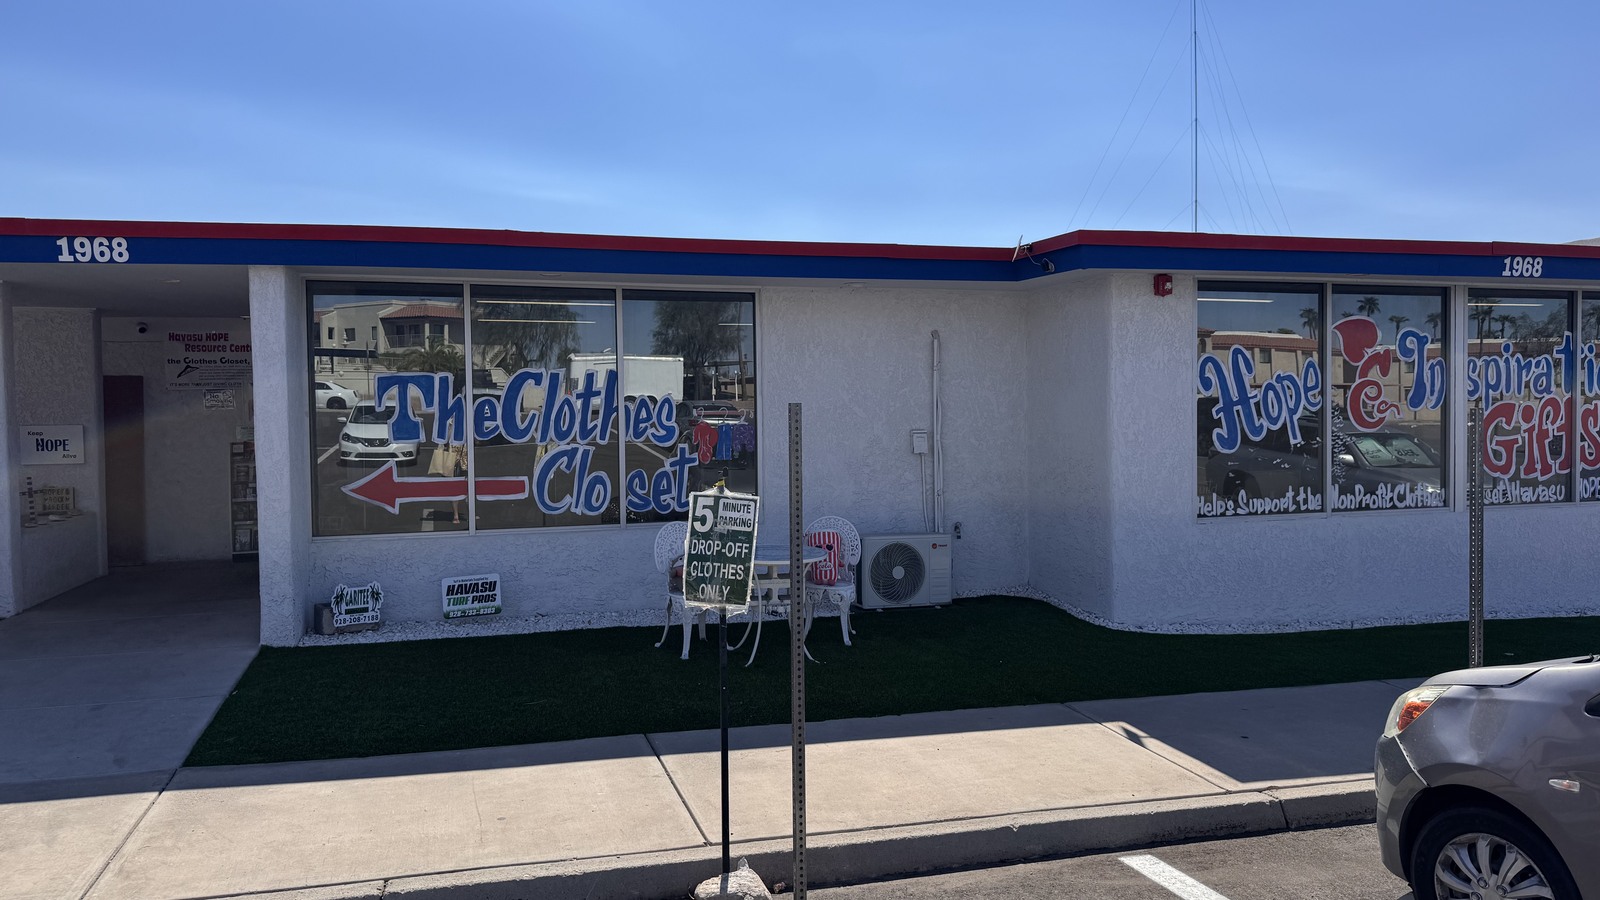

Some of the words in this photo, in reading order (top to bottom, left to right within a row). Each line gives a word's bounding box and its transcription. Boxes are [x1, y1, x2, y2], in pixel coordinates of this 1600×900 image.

[56, 236, 129, 263] 1968
[1501, 256, 1543, 277] 1968
[168, 332, 203, 341] Havasu
[205, 332, 229, 341] HOPE
[184, 343, 227, 352] Resource
[229, 343, 252, 352] Cent
[183, 356, 217, 365] Clothes
[220, 356, 251, 366] Closet,
[374, 371, 500, 444] The
[500, 367, 679, 447] Clothes
[1198, 344, 1322, 454] Hope
[36, 438, 70, 452] HOPE
[1483, 395, 1600, 481] Gifts
[533, 443, 699, 515] Closet
[722, 501, 752, 514] MINUTE
[1236, 485, 1297, 515] Support
[1296, 486, 1322, 511] the
[692, 496, 715, 533] 5
[718, 515, 752, 529] PARKING
[691, 540, 750, 558] DROP-OFF
[690, 561, 744, 580] CLOTHES
[446, 580, 497, 597] HAVASU
[699, 583, 730, 601] ONLY
[447, 596, 470, 607] TURF
[471, 593, 497, 604] PROS
